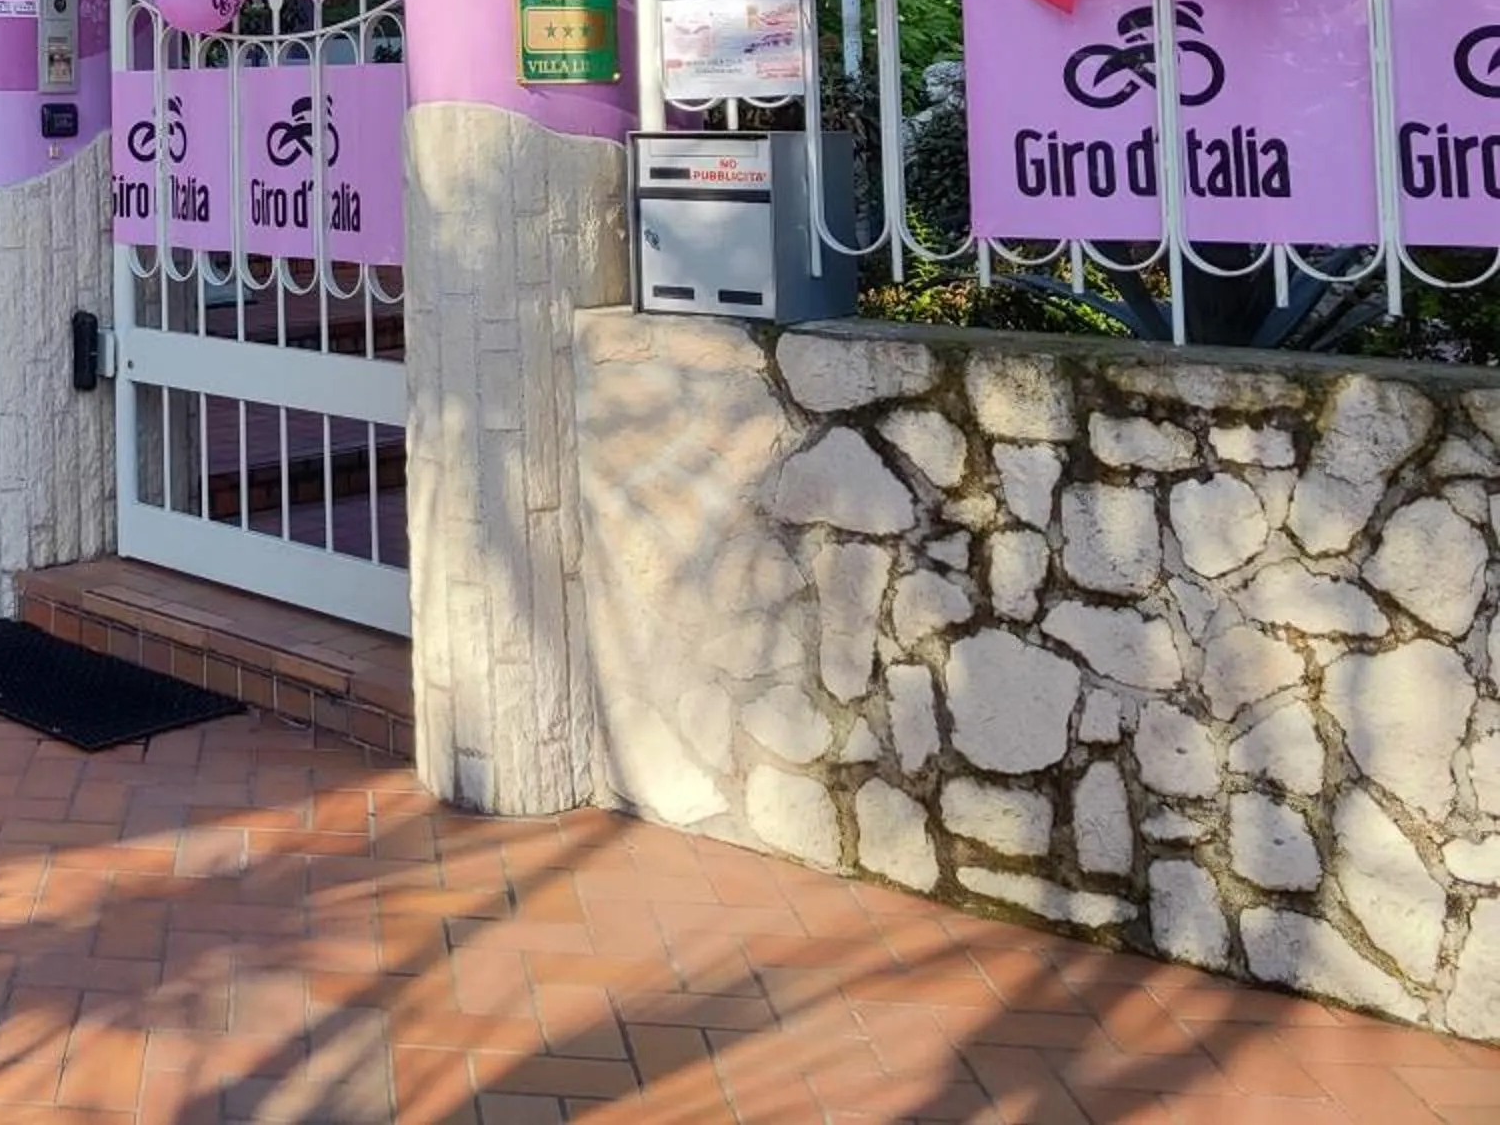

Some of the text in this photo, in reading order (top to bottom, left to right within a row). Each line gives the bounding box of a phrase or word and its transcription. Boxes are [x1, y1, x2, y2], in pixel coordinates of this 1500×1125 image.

[527, 59, 570, 74] VILLA
[719, 159, 737, 169] NO
[1015, 125, 1291, 197] Giro dtalia
[252, 179, 361, 232] Giro d'alia
